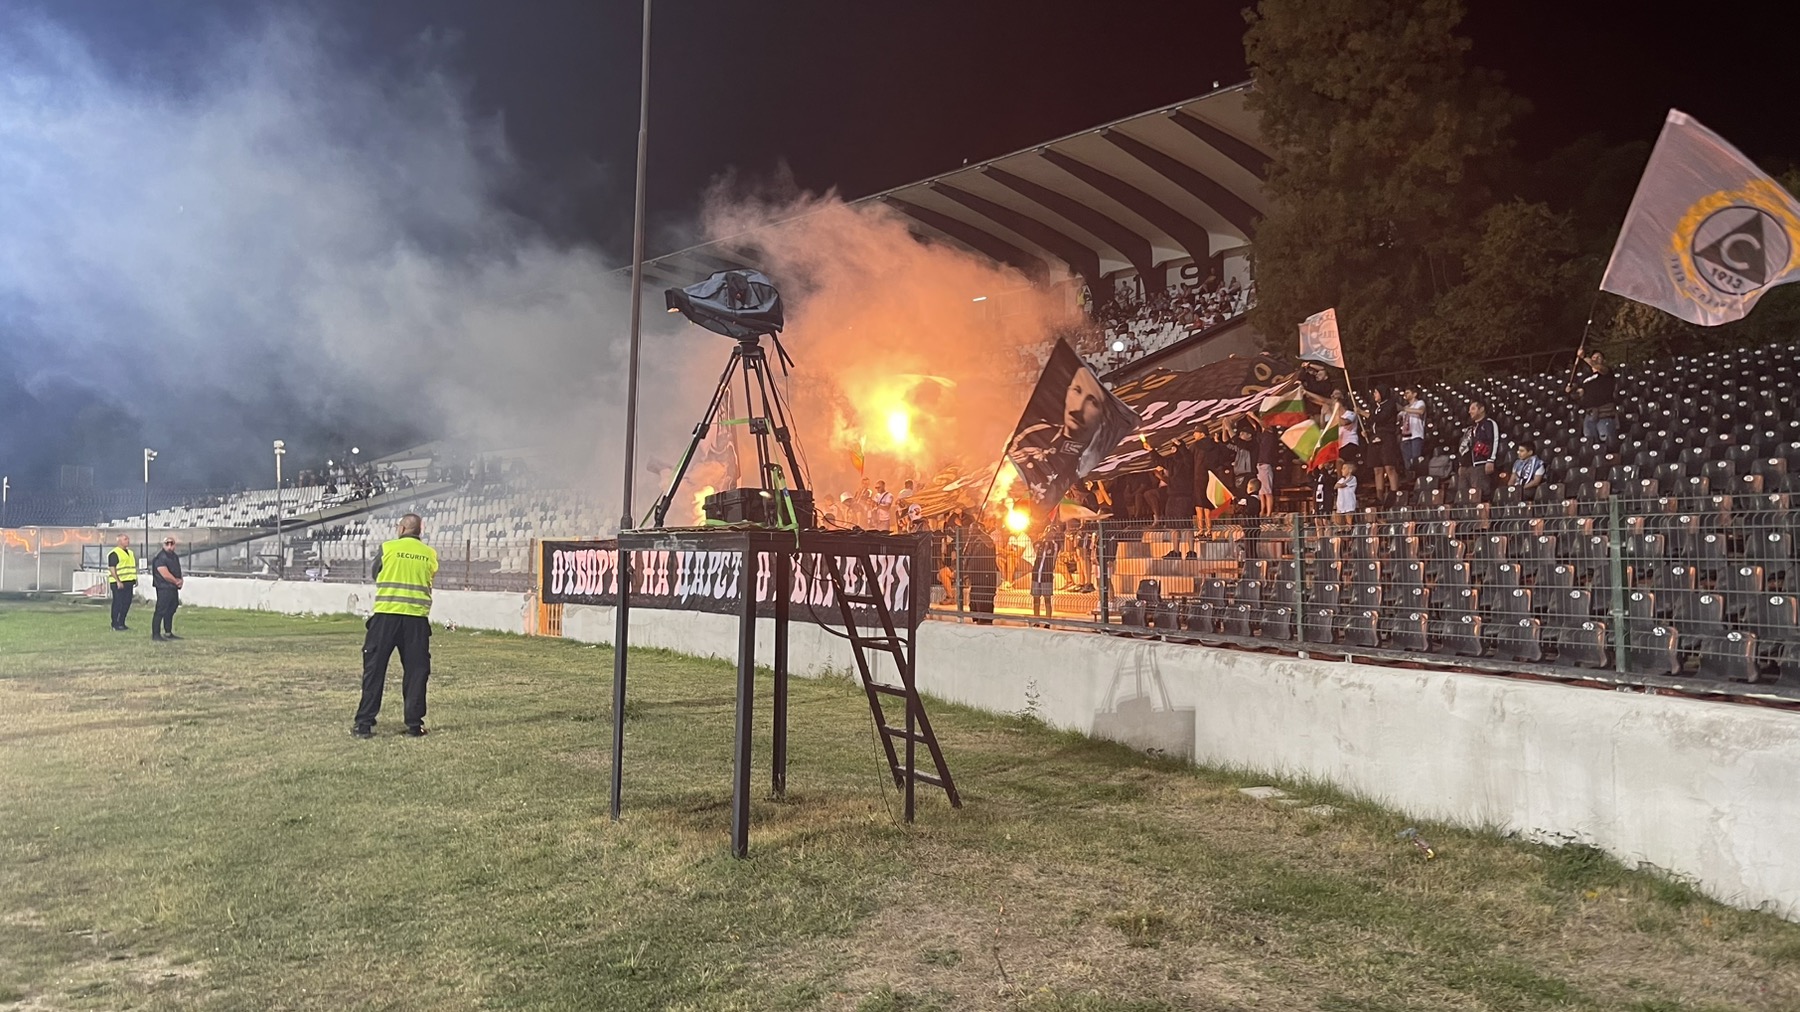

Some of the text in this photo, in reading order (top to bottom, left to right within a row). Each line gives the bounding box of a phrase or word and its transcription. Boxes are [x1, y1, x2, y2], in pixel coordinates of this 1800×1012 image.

[1711, 268, 1743, 289] 1913
[396, 552, 430, 562] SECURITY
[640, 551, 670, 597] НА
[673, 551, 771, 604] ЦАРСТО
